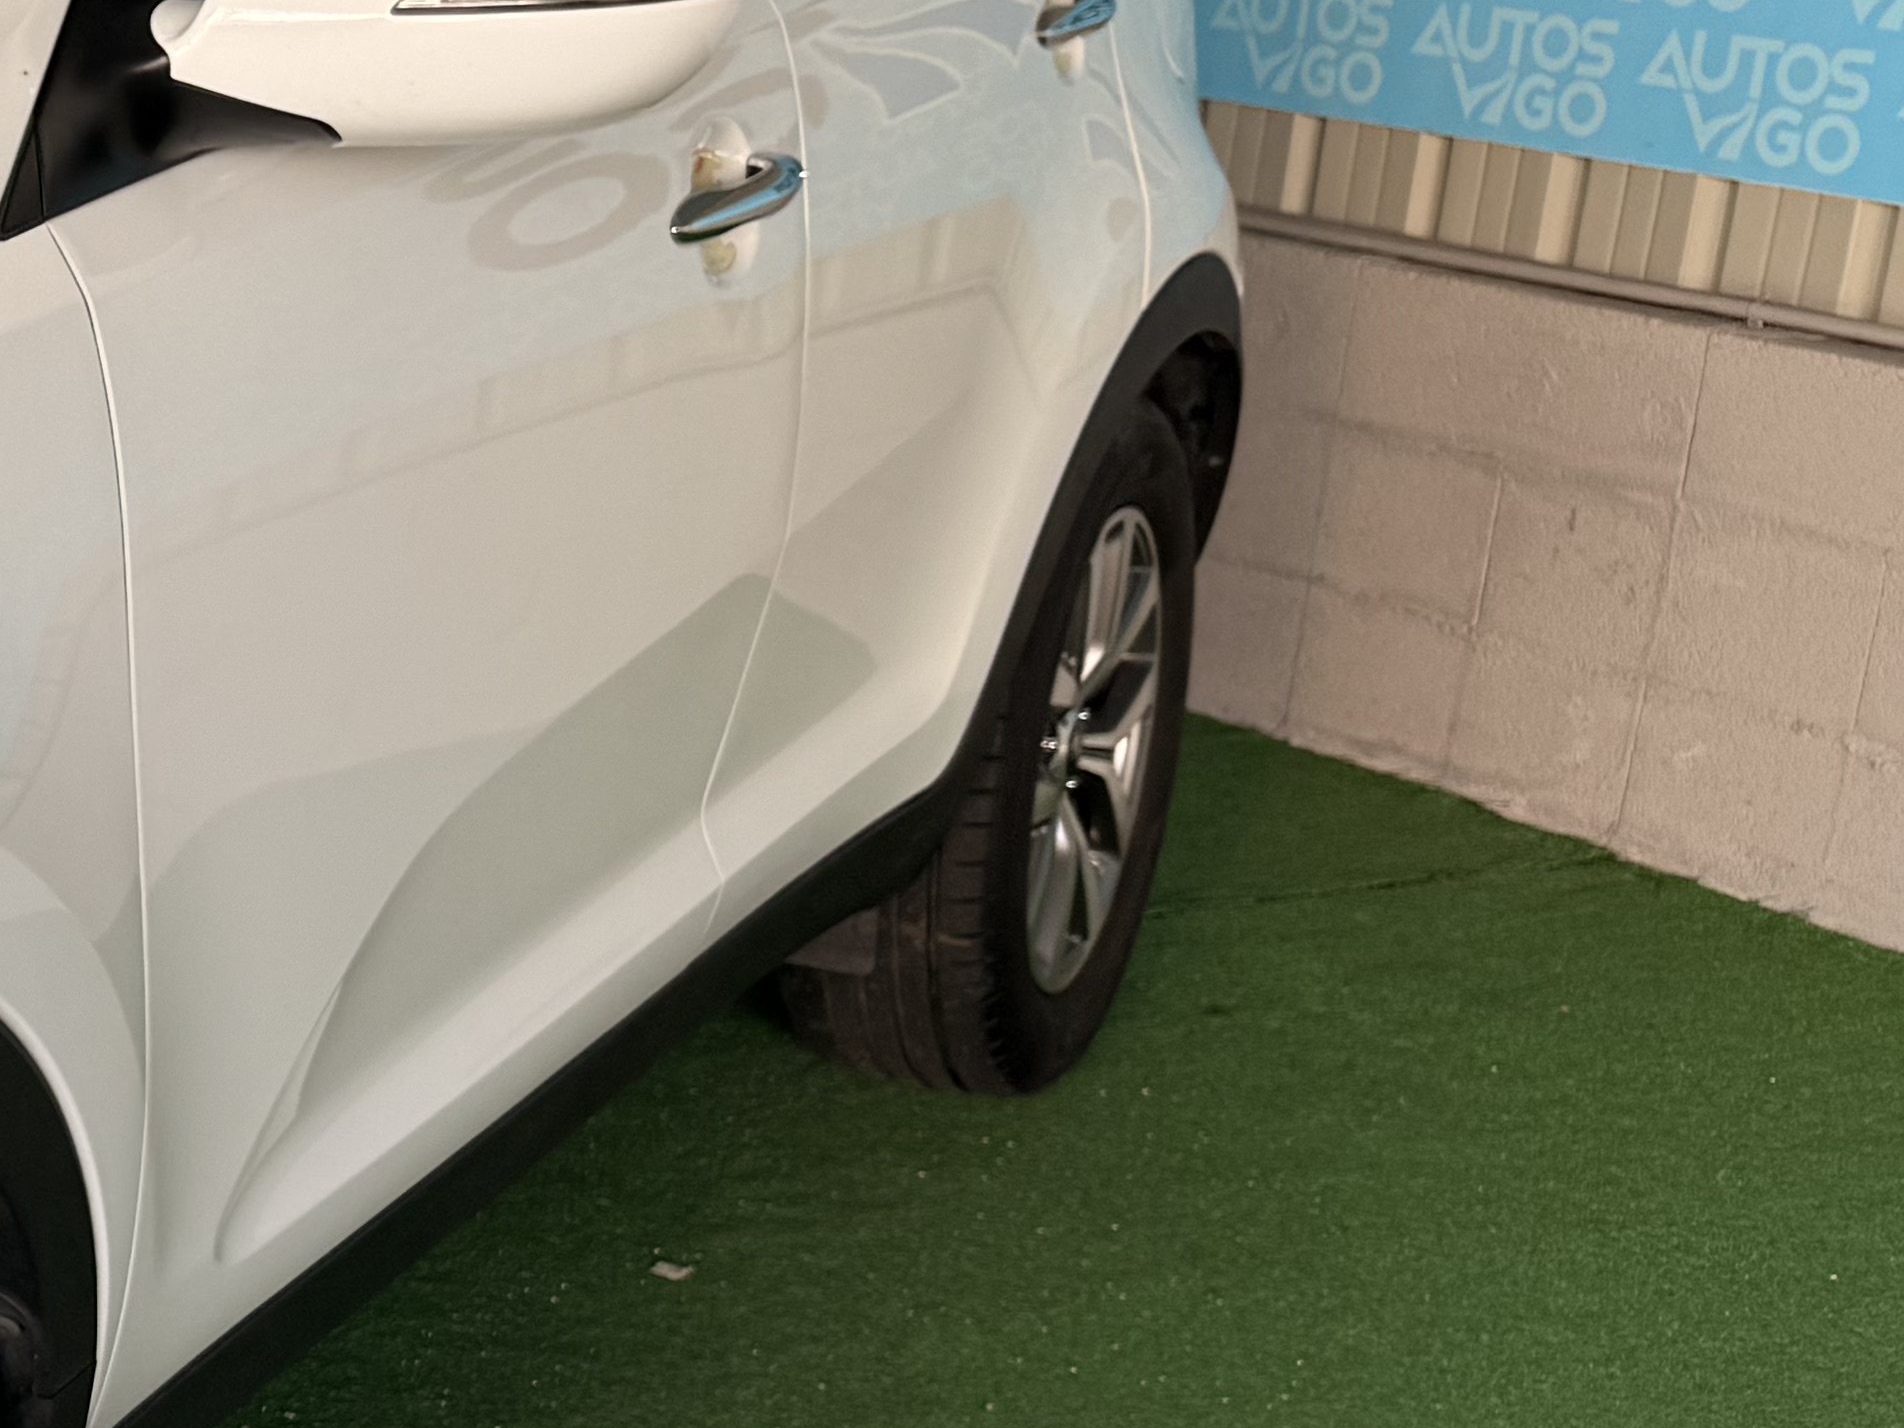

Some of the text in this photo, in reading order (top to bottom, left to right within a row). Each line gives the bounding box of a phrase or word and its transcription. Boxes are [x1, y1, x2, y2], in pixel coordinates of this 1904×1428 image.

[1248, 36, 1381, 103] VIGO
[1412, 3, 1617, 76] AUTOS
[1640, 30, 1874, 110] AUTOS
[1453, 64, 1605, 136] VIGO
[1684, 94, 1859, 174] VIGO
